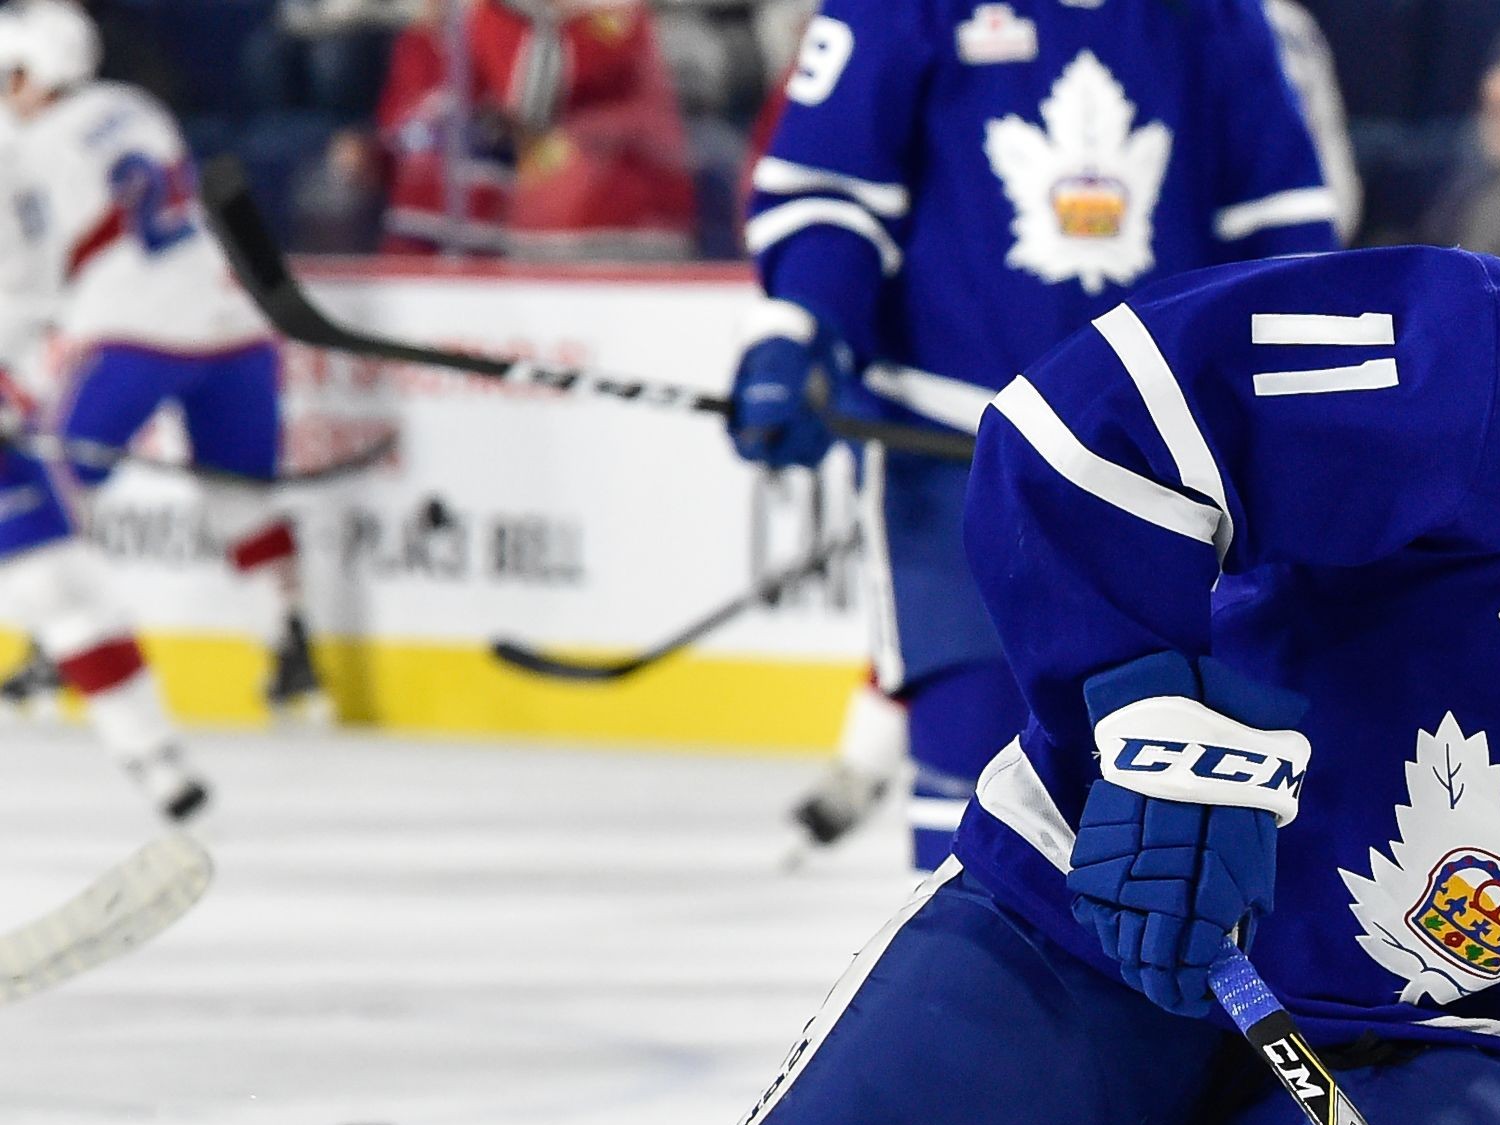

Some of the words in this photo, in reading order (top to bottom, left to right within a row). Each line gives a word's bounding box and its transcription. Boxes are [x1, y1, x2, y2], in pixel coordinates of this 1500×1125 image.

[1252, 312, 1398, 396] 11
[1114, 738, 1305, 800] CCM
[1262, 1038, 1325, 1102] CM
